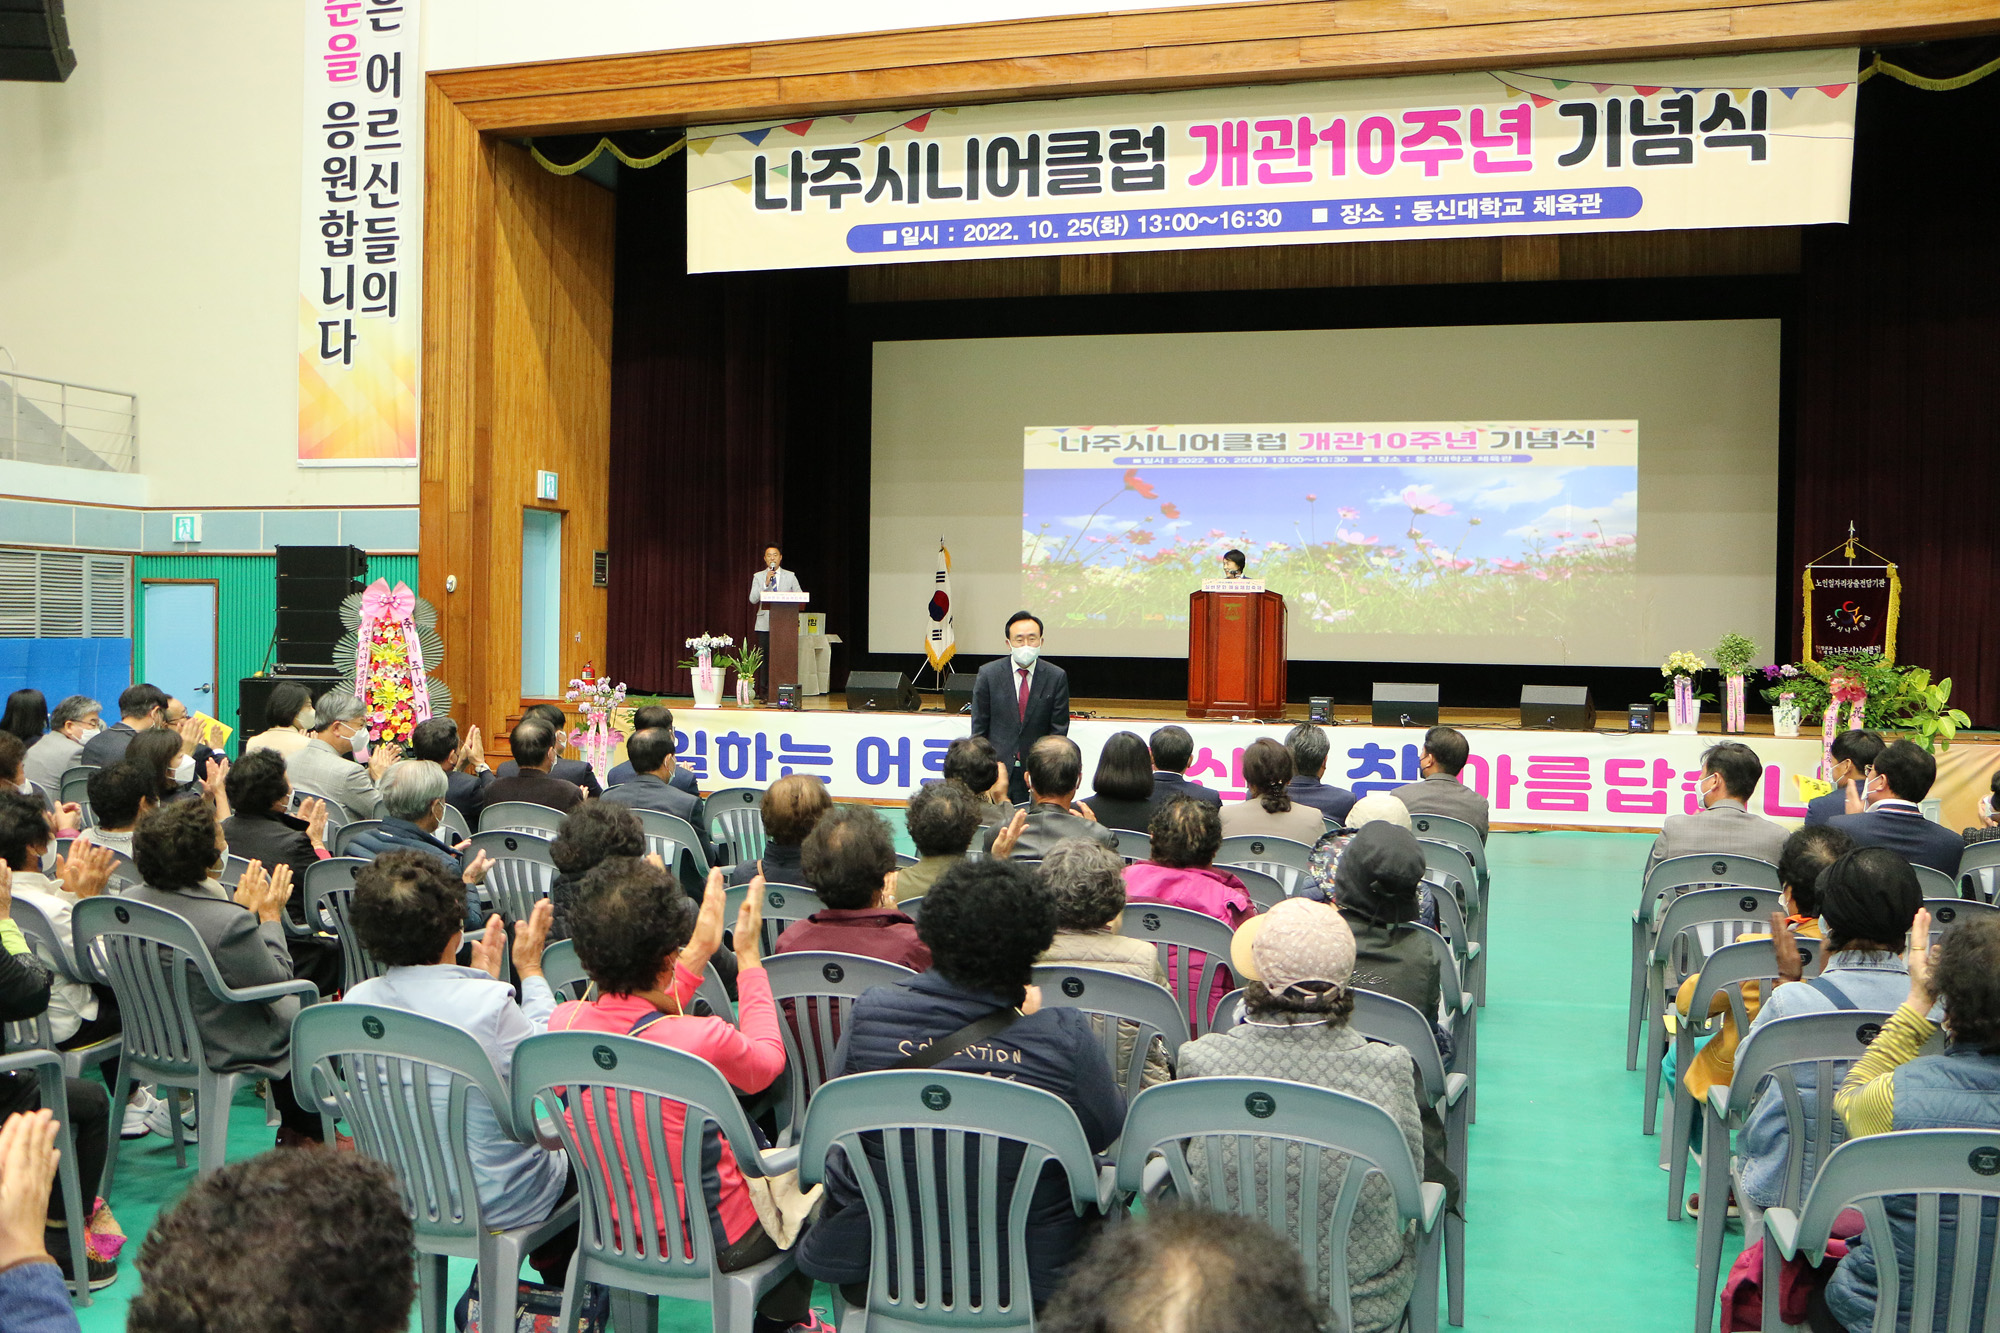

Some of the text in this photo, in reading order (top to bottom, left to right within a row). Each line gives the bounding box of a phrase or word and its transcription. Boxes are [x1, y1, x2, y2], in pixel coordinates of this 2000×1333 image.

[362, 51, 402, 318] 어르신들의
[754, 89, 1768, 211] 나주시니어클럽 개관10주년 기념식
[318, 101, 360, 365] 응원합니다
[901, 225, 939, 246] 일시
[963, 222, 1019, 243] 2022.
[1028, 220, 1059, 239] 10.
[1067, 213, 1129, 240] 25(화)
[1138, 208, 1282, 234] 13:00~16:30
[1340, 204, 1385, 225] 장소
[1411, 195, 1525, 222] 동신대학교
[1533, 192, 1603, 217] 체육관
[1061, 430, 1595, 452] 나주시니어클럽 개관10주년 기념식
